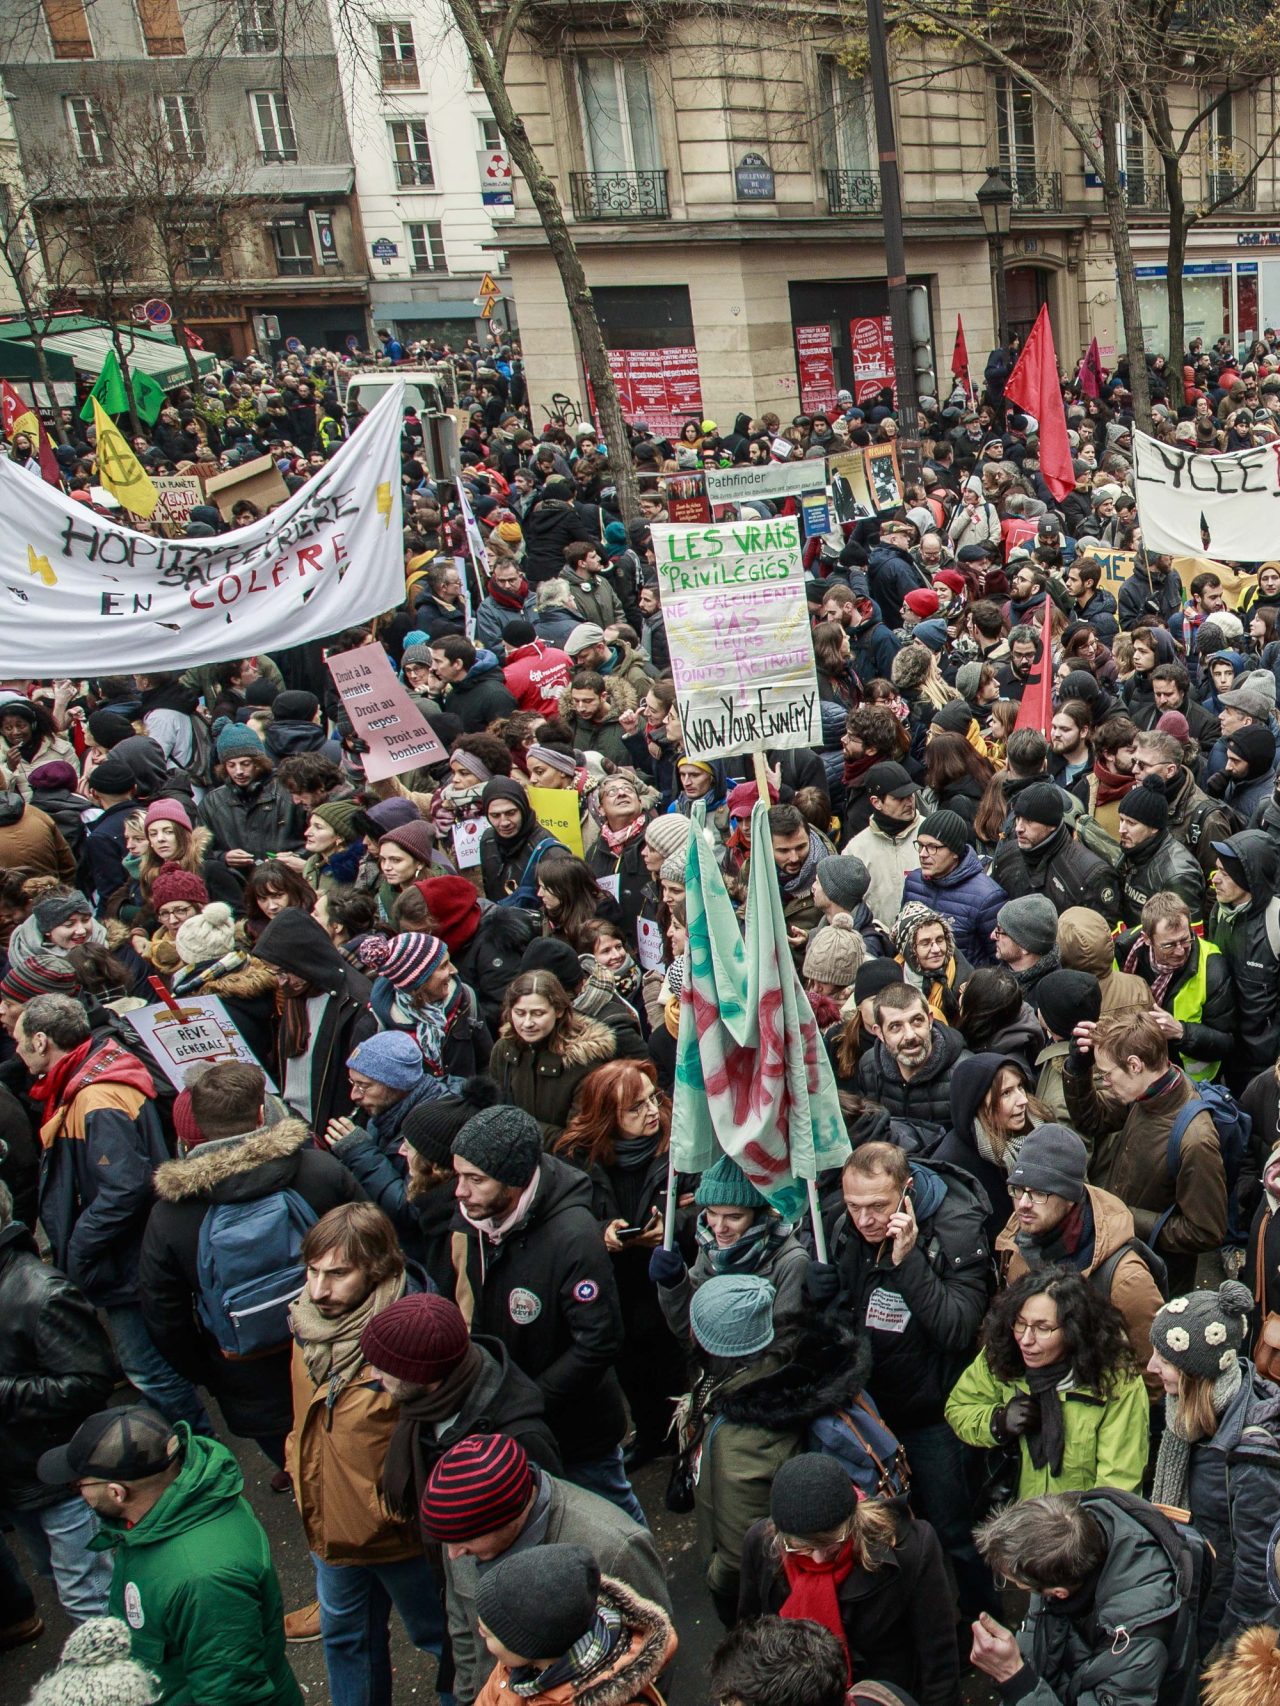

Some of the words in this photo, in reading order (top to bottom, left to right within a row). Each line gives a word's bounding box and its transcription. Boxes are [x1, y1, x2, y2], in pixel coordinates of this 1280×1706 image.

[1237, 233, 1260, 244] Crédit
[168, 478, 196, 488] PLANÈTE
[708, 472, 766, 488] Pathfinder
[100, 592, 152, 616] EN
[190, 533, 348, 610] COLÈRE
[666, 601, 688, 618] NE
[703, 586, 801, 612] CALCULENT
[710, 608, 760, 637] PAS
[715, 635, 764, 650] LEURS
[336, 670, 353, 683] Droit
[354, 666, 361, 678] à
[362, 664, 372, 676] la
[672, 658, 726, 692] POINTS
[735, 648, 810, 680] RETRAITE
[342, 682, 371, 698] retraite
[354, 702, 380, 718] Droit
[381, 699, 395, 710] au
[368, 714, 398, 730] repos
[384, 730, 413, 746] Droit
[414, 727, 427, 737] au
[389, 740, 436, 761] bonheur
[1247, 960, 1264, 968] adidas
[178, 1025, 210, 1042] RÊVE
[175, 1039, 226, 1057] GÉNÉRALE
